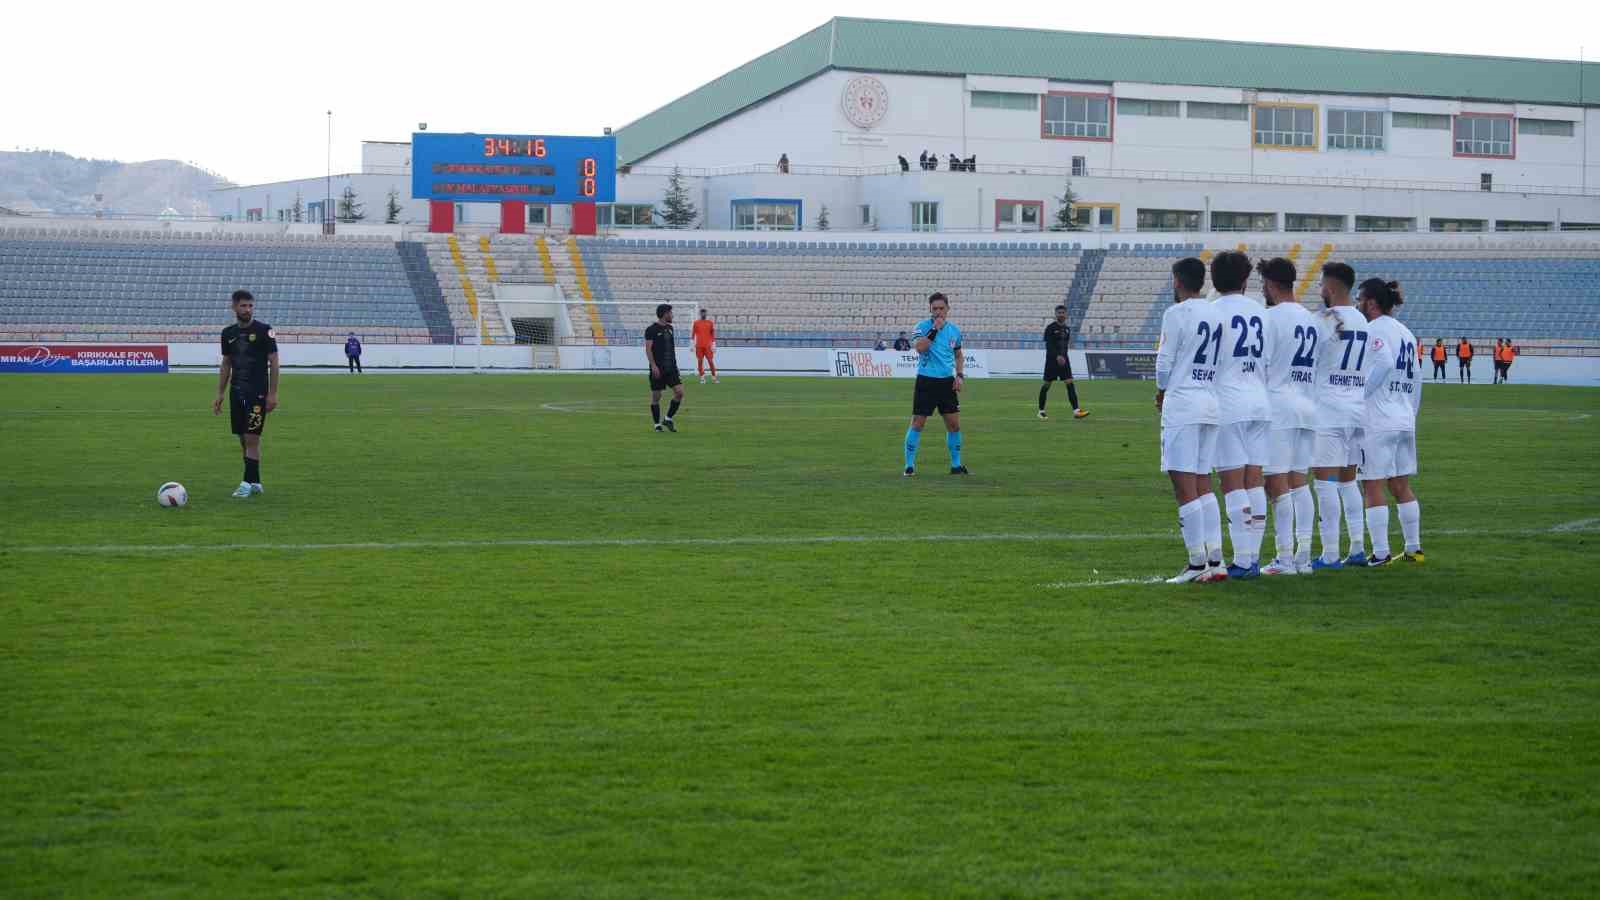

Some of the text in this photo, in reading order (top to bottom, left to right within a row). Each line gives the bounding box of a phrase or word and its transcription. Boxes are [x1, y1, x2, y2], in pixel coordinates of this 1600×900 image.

[584, 159, 595, 176] 0
[584, 178, 595, 196] 0
[1192, 321, 1223, 366] 21
[1231, 315, 1263, 358] 23
[1291, 325, 1318, 368] 22
[1340, 330, 1368, 371] 77
